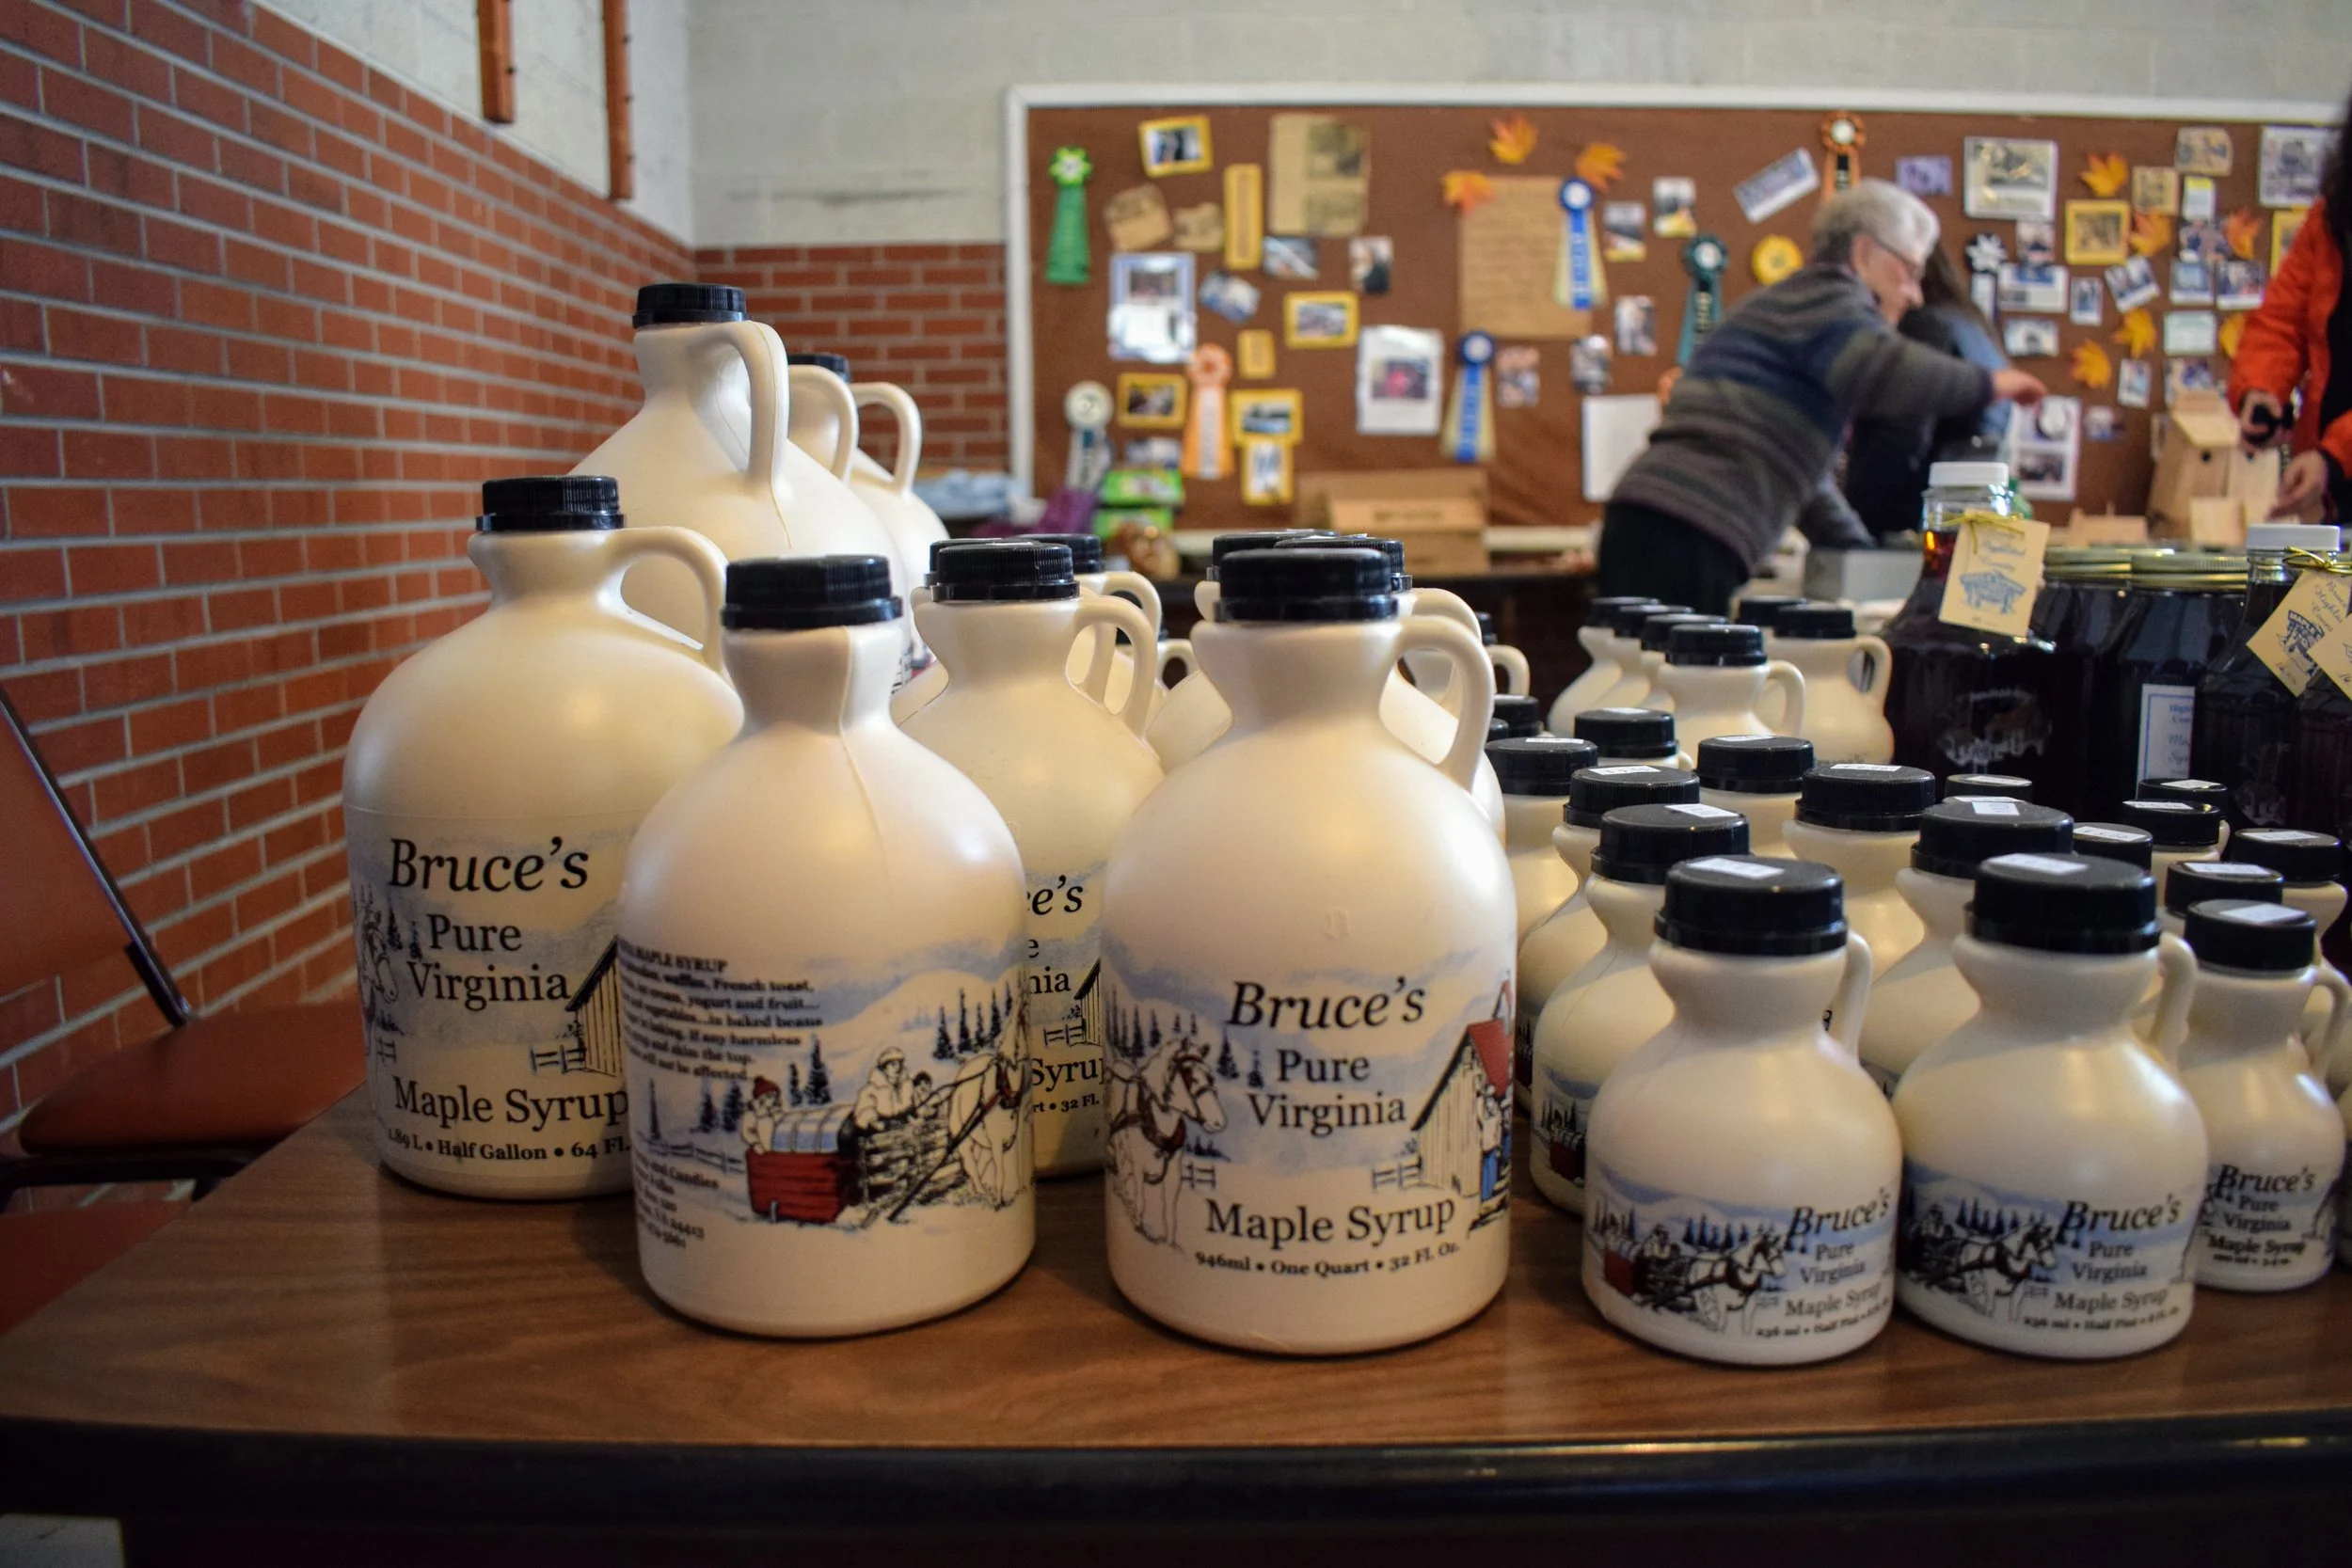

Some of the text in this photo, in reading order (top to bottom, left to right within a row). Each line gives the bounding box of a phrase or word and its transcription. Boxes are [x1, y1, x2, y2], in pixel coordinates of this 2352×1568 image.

[389, 836, 589, 892] Bruce's
[426, 913, 522, 953] Pure
[406, 962, 571, 1011] Virginia
[735, 997, 764, 1009] and
[1227, 975, 1427, 1030] Bruce's
[1277, 1048, 1371, 1083] Pure
[392, 1074, 628, 1132] Maple Syrup
[1060, 1099, 1078, 1113] 32
[1248, 1091, 1407, 1137] Virginia
[437, 1139, 476, 1160] Half
[480, 1144, 548, 1160] Gallon
[571, 1141, 598, 1159] 64
[2214, 1164, 2316, 1203] Bruce's
[1785, 1186, 1892, 1254] Bruce's
[2055, 1192, 2182, 1250] Bruce's
[2238, 1195, 2279, 1212] Pure
[1204, 1196, 1455, 1250] Maple Syrup
[1194, 1250, 1250, 1271] 946ml
[1270, 1259, 1310, 1275] One
[1315, 1259, 1370, 1278] Quart
[1389, 1254, 1410, 1271] 32
[1815, 1242, 1855, 1261] Pure
[2088, 1240, 2134, 1259] Pure
[2070, 1260, 2149, 1284] Virginia
[1785, 1293, 1842, 1319] Maple
[2054, 1291, 2117, 1315] Maple
